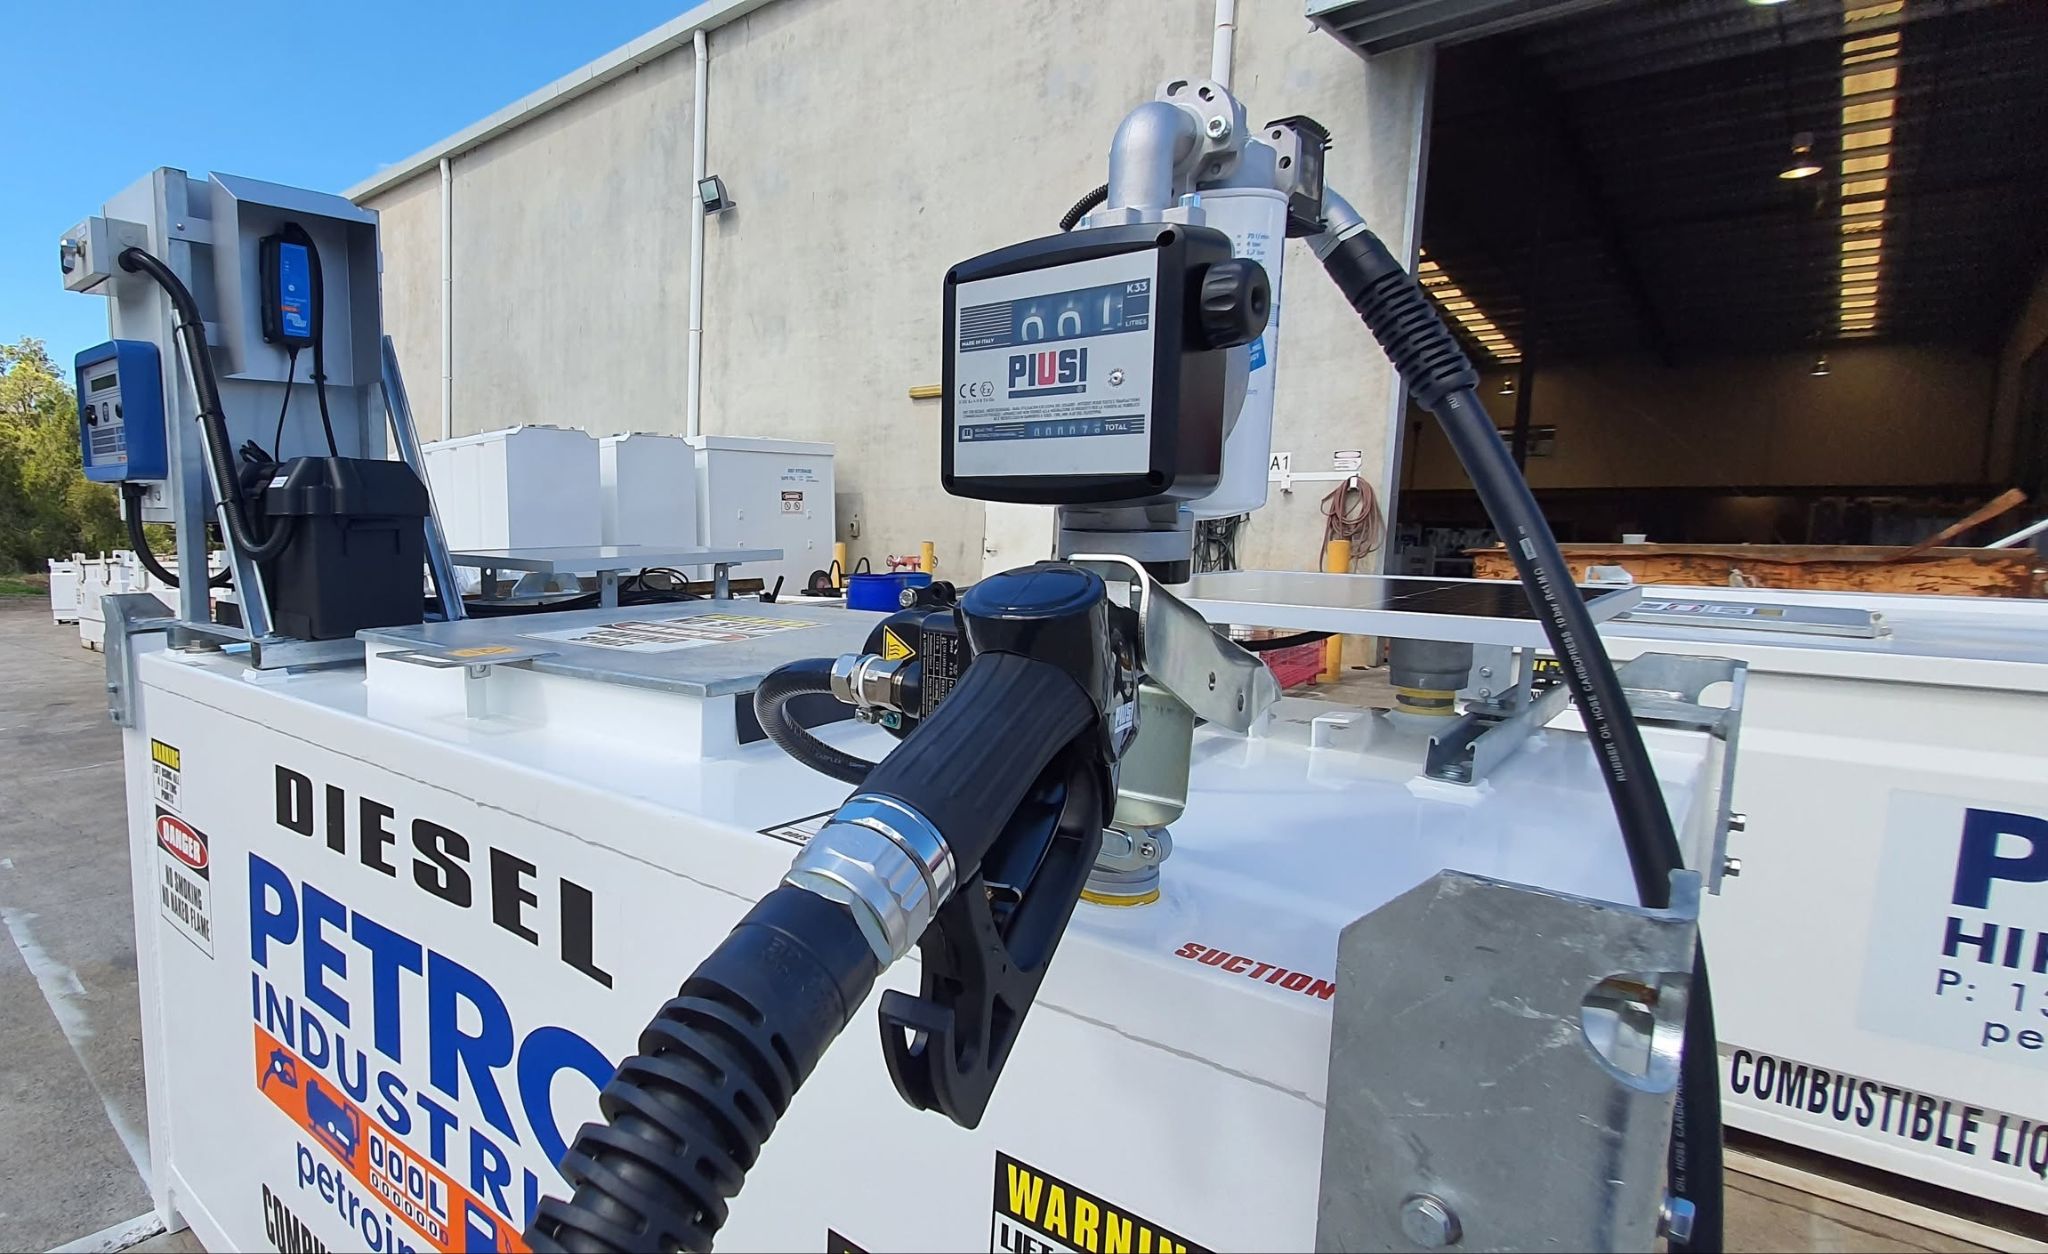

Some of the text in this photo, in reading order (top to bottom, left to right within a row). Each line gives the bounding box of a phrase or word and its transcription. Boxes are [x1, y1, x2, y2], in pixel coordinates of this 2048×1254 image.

[1127, 282, 1148, 294] K33
[1125, 319, 1147, 327] LITRES
[1008, 348, 1088, 388] PIUSI
[1105, 423, 1128, 431] TOTAL
[1270, 456, 1289, 471] A1
[1587, 695, 1605, 720] HOSE
[1599, 723, 1612, 739] OIL
[1605, 742, 1627, 782] RUBBER
[162, 820, 201, 864] DANGER
[165, 864, 202, 911] NO SMOKING
[275, 764, 613, 989] DIESEL
[162, 884, 210, 942] NO NAKED FLAME
[1174, 942, 1335, 1001] SUCTION
[1936, 968, 1976, 1002] P:
[249, 850, 617, 1191] PETRO
[1981, 1021, 2045, 1050] pe
[1731, 1050, 1984, 1155] COMBUSTIBLE
[370, 1135, 446, 1220] 000L
[262, 1182, 332, 1253] COM
